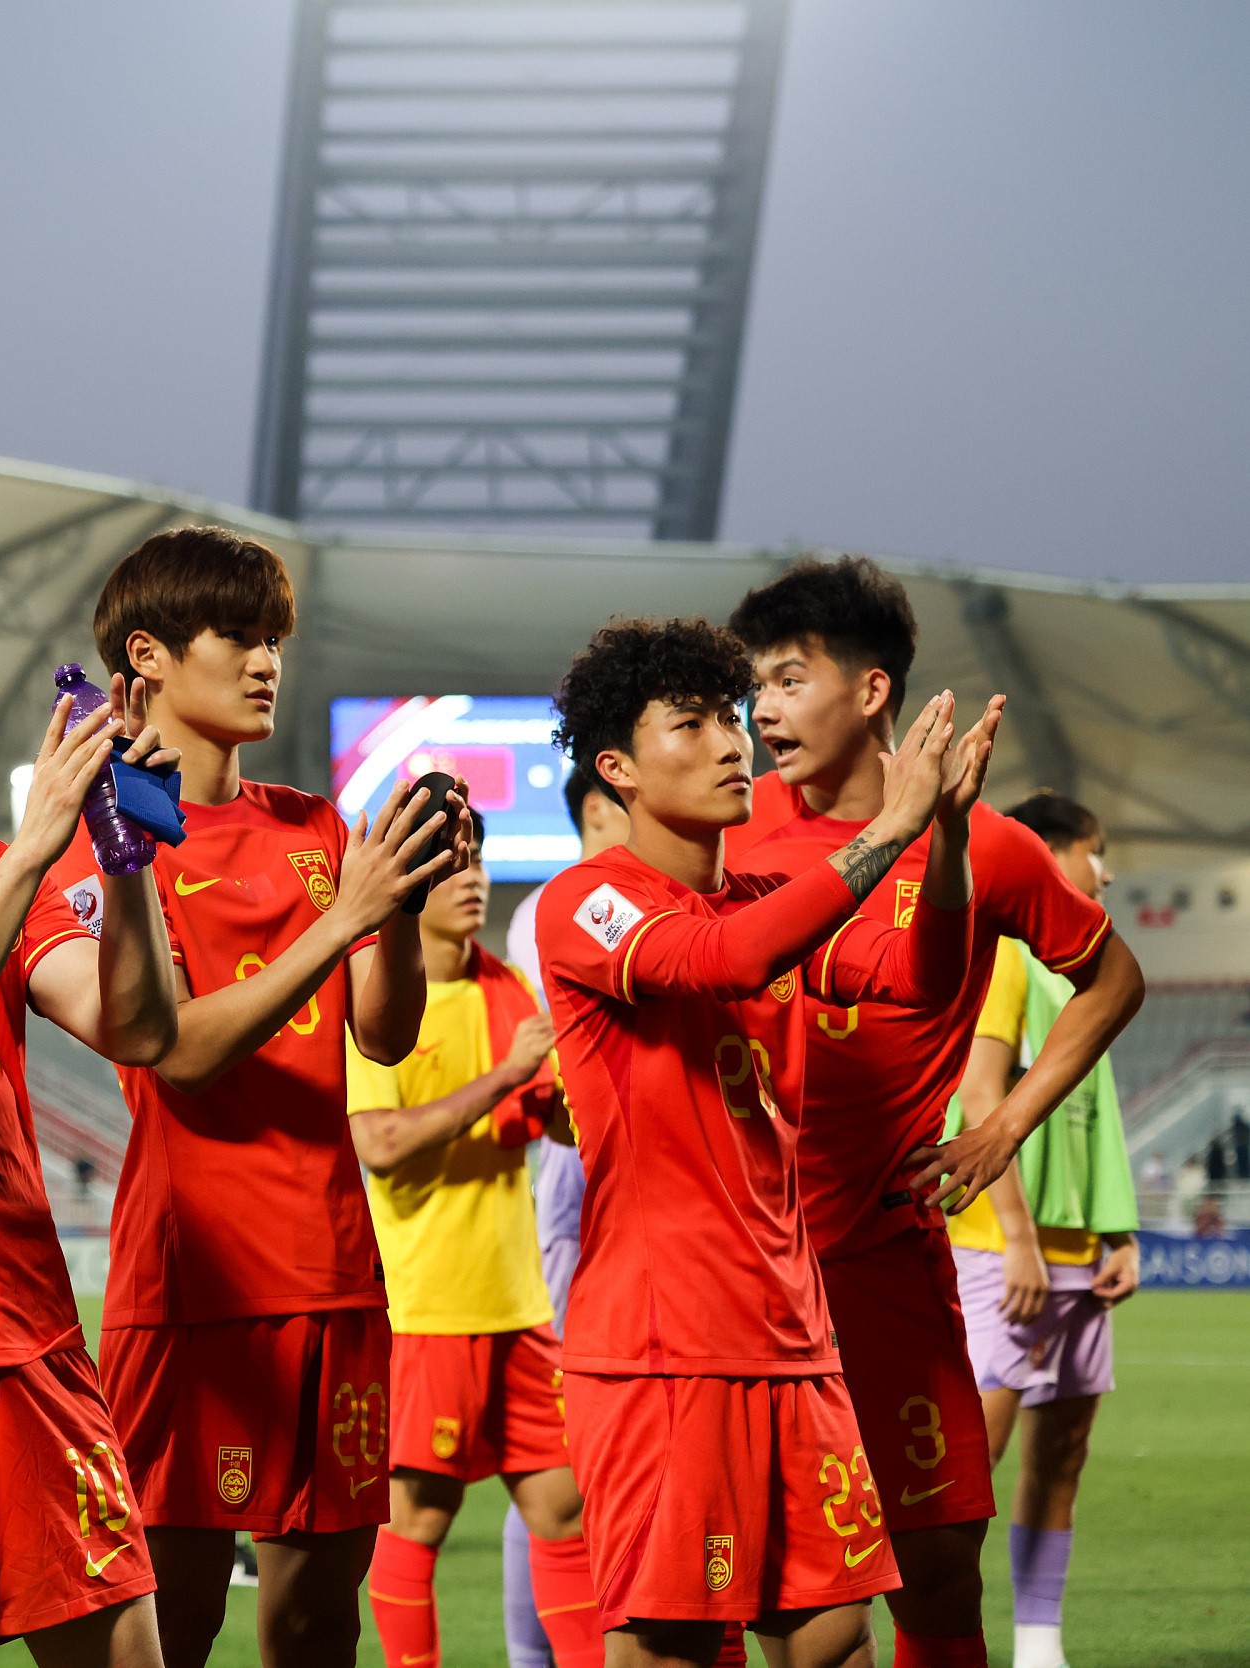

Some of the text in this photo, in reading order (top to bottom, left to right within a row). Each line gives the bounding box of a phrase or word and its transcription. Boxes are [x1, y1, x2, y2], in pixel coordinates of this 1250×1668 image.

[293, 854, 324, 867] CFA
[901, 885, 921, 898] CF
[605, 922, 616, 937] AFC
[606, 925, 623, 944] ASIAN
[332, 1382, 386, 1467] 20
[899, 1395, 946, 1470] 3
[221, 1450, 249, 1461] CFA
[65, 1441, 131, 1539] 10
[818, 1444, 882, 1537] 23
[706, 1539, 730, 1550] CFA
